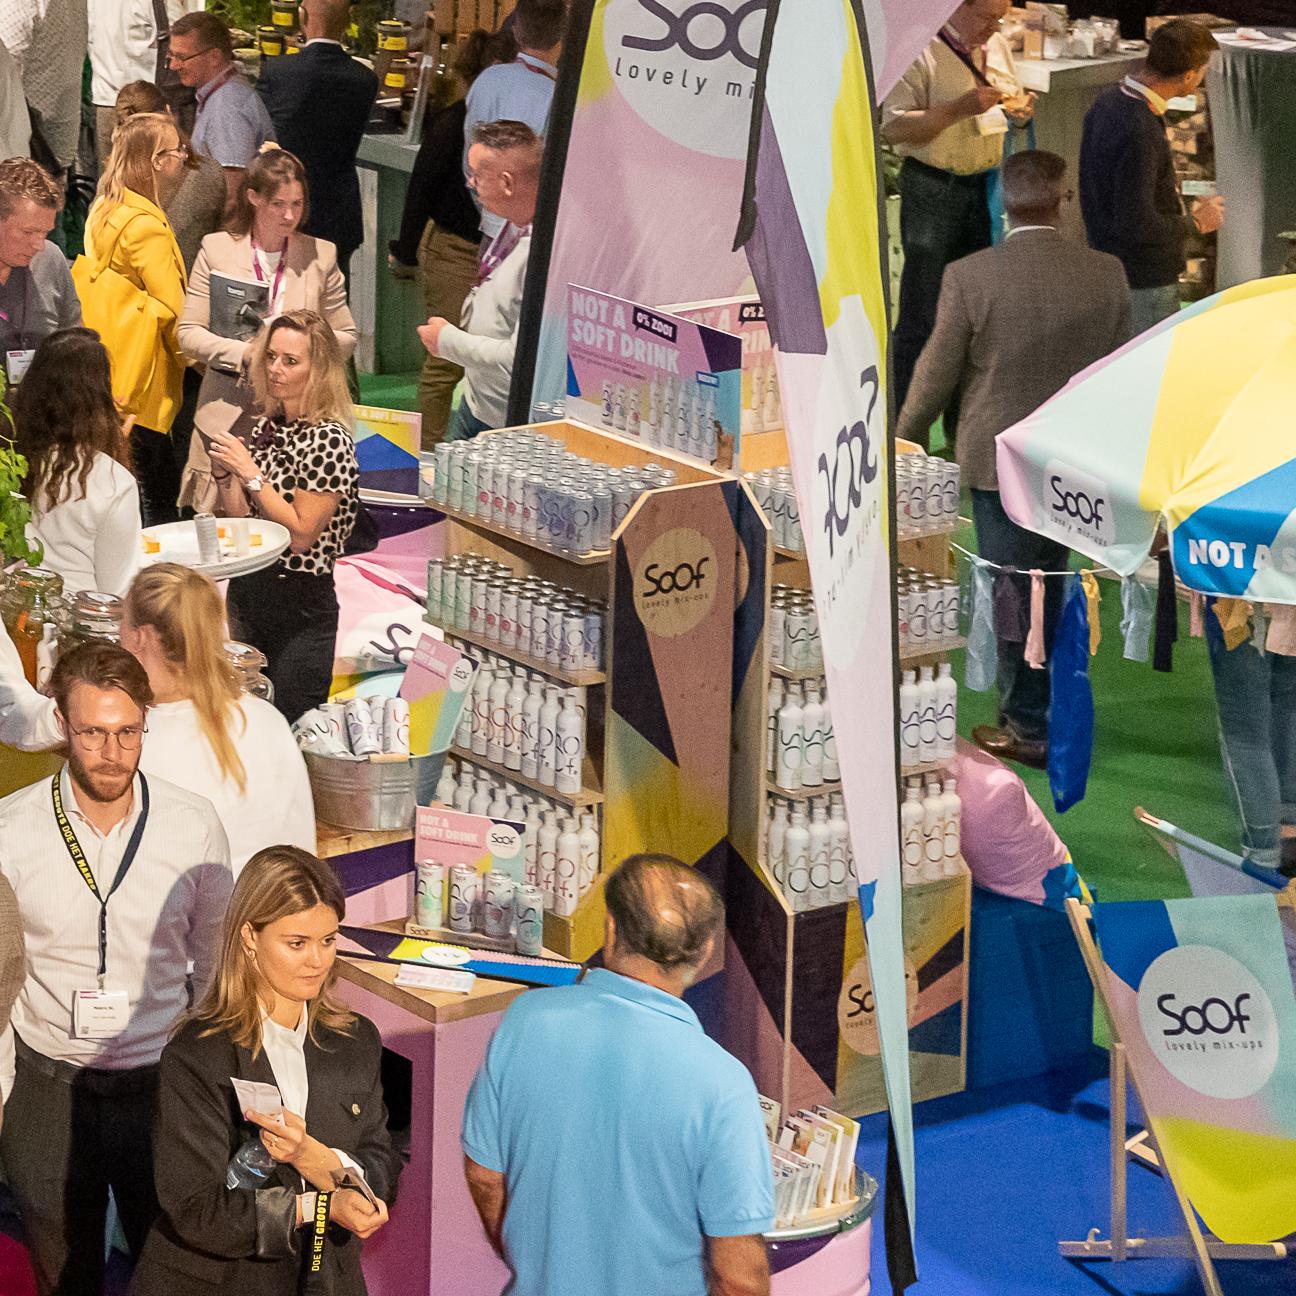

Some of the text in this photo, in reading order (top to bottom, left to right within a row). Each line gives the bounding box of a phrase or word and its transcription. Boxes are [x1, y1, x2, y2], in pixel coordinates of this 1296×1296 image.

[614, 56, 708, 96] lovely
[571, 291, 626, 330] NOT A
[571, 319, 616, 352] SOFT
[621, 333, 681, 375] DRINK
[1188, 538, 1247, 569] NOT
[1165, 1040, 1206, 1053] lovely
[311, 1194, 328, 1272] DOE HET GROOTS
